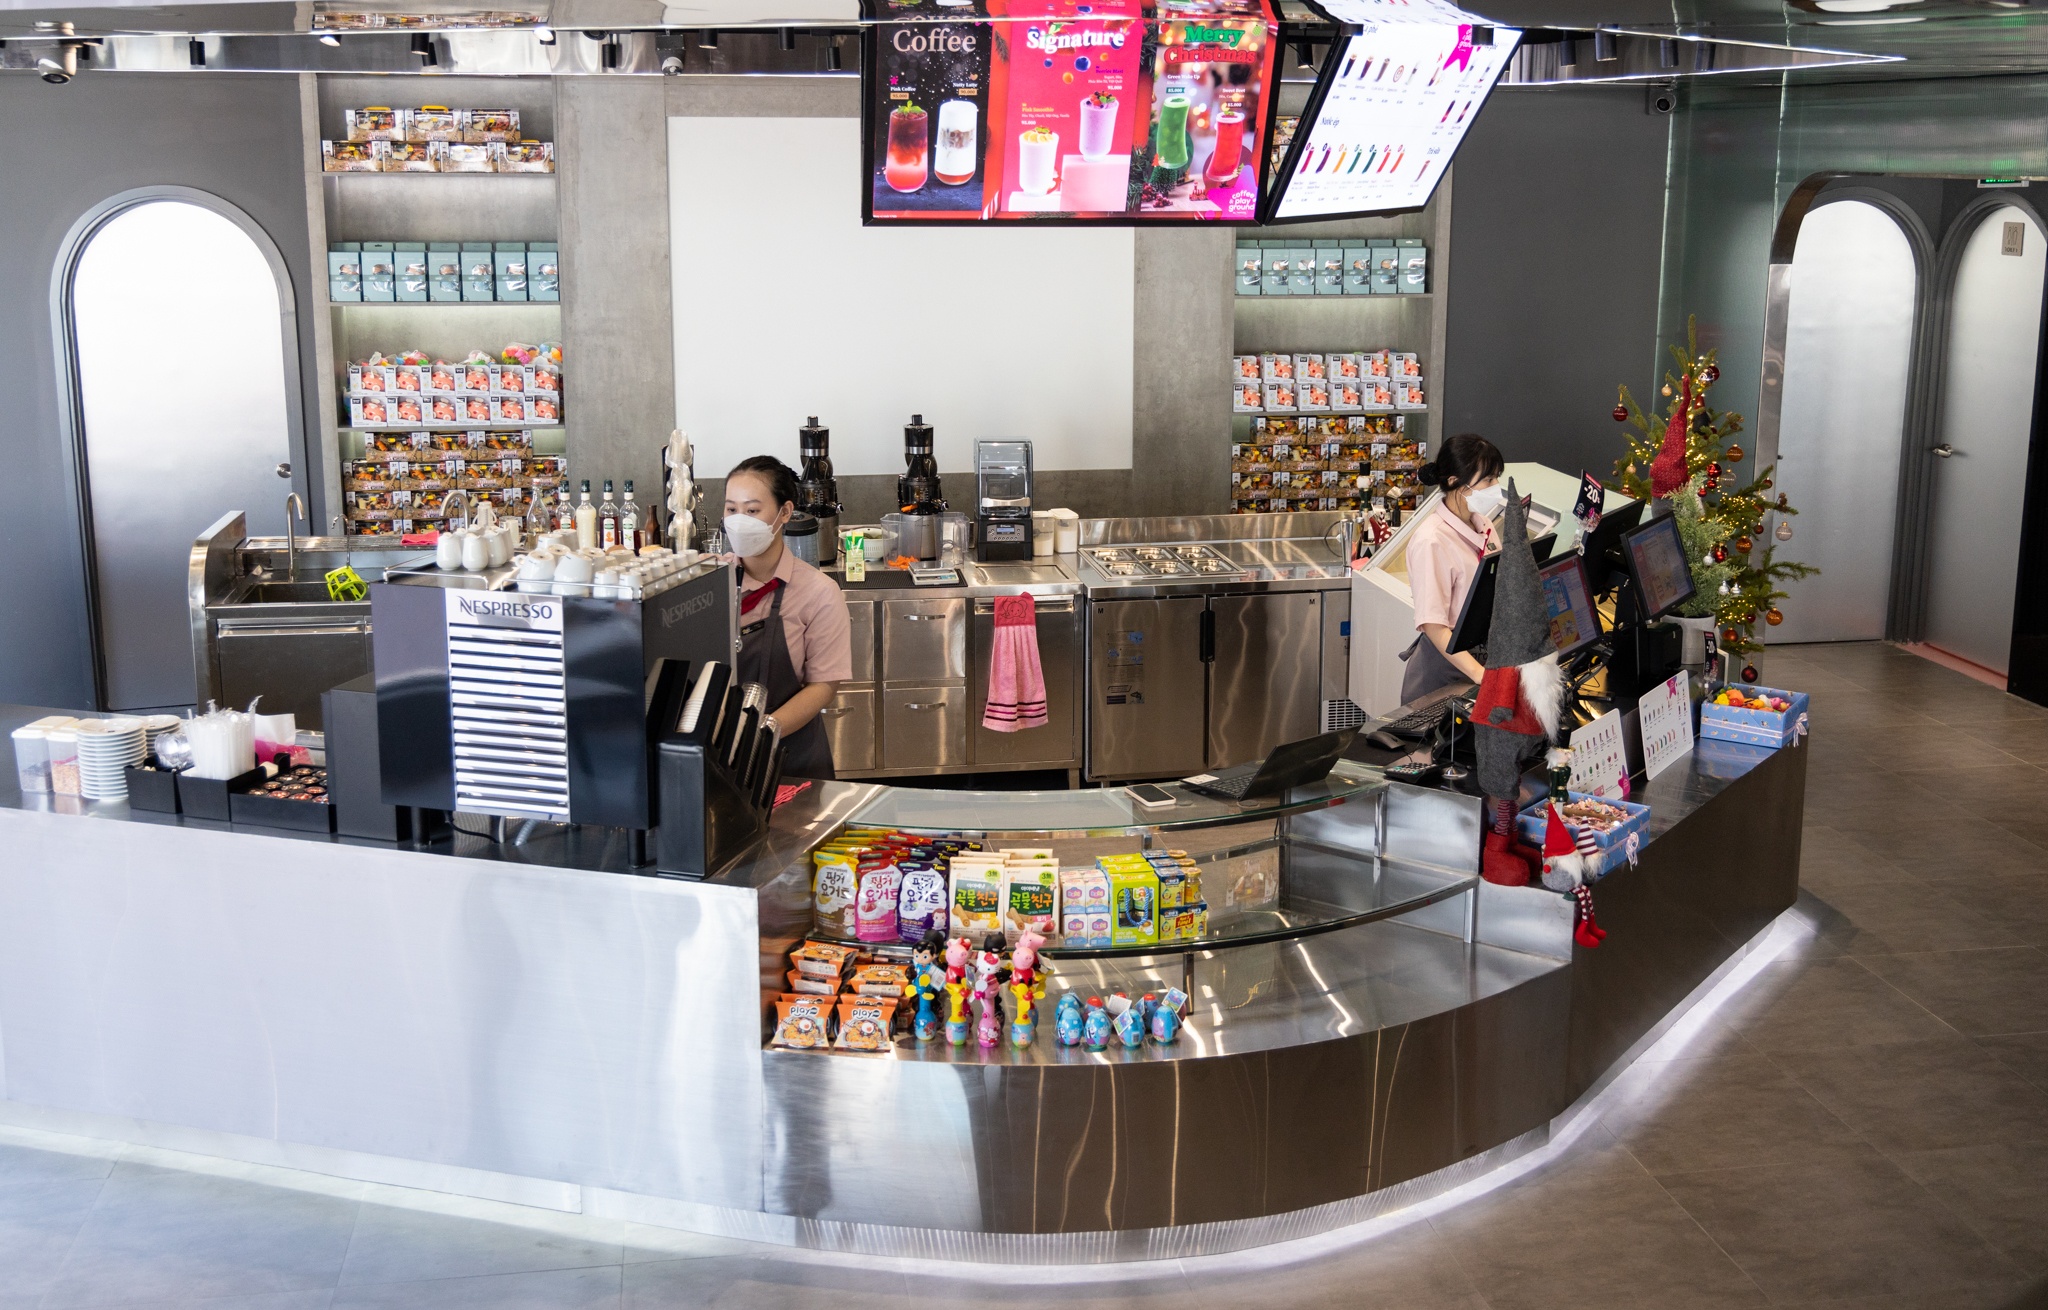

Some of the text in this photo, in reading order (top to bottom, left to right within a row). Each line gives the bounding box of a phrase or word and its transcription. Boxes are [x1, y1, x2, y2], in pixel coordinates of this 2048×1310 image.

[893, 28, 976, 52] Coffee
[1026, 29, 1124, 54] Signature
[1184, 26, 1245, 48] Merry
[1164, 44, 1256, 64] Christmas
[1232, 190, 1254, 199] coffee
[1235, 198, 1251, 206] play
[1229, 204, 1255, 212] ground
[458, 596, 552, 619] NESPRESSO
[661, 591, 713, 628] NESPRESSO
[826, 872, 845, 885] 핑거
[821, 880, 850, 899] 요거트
